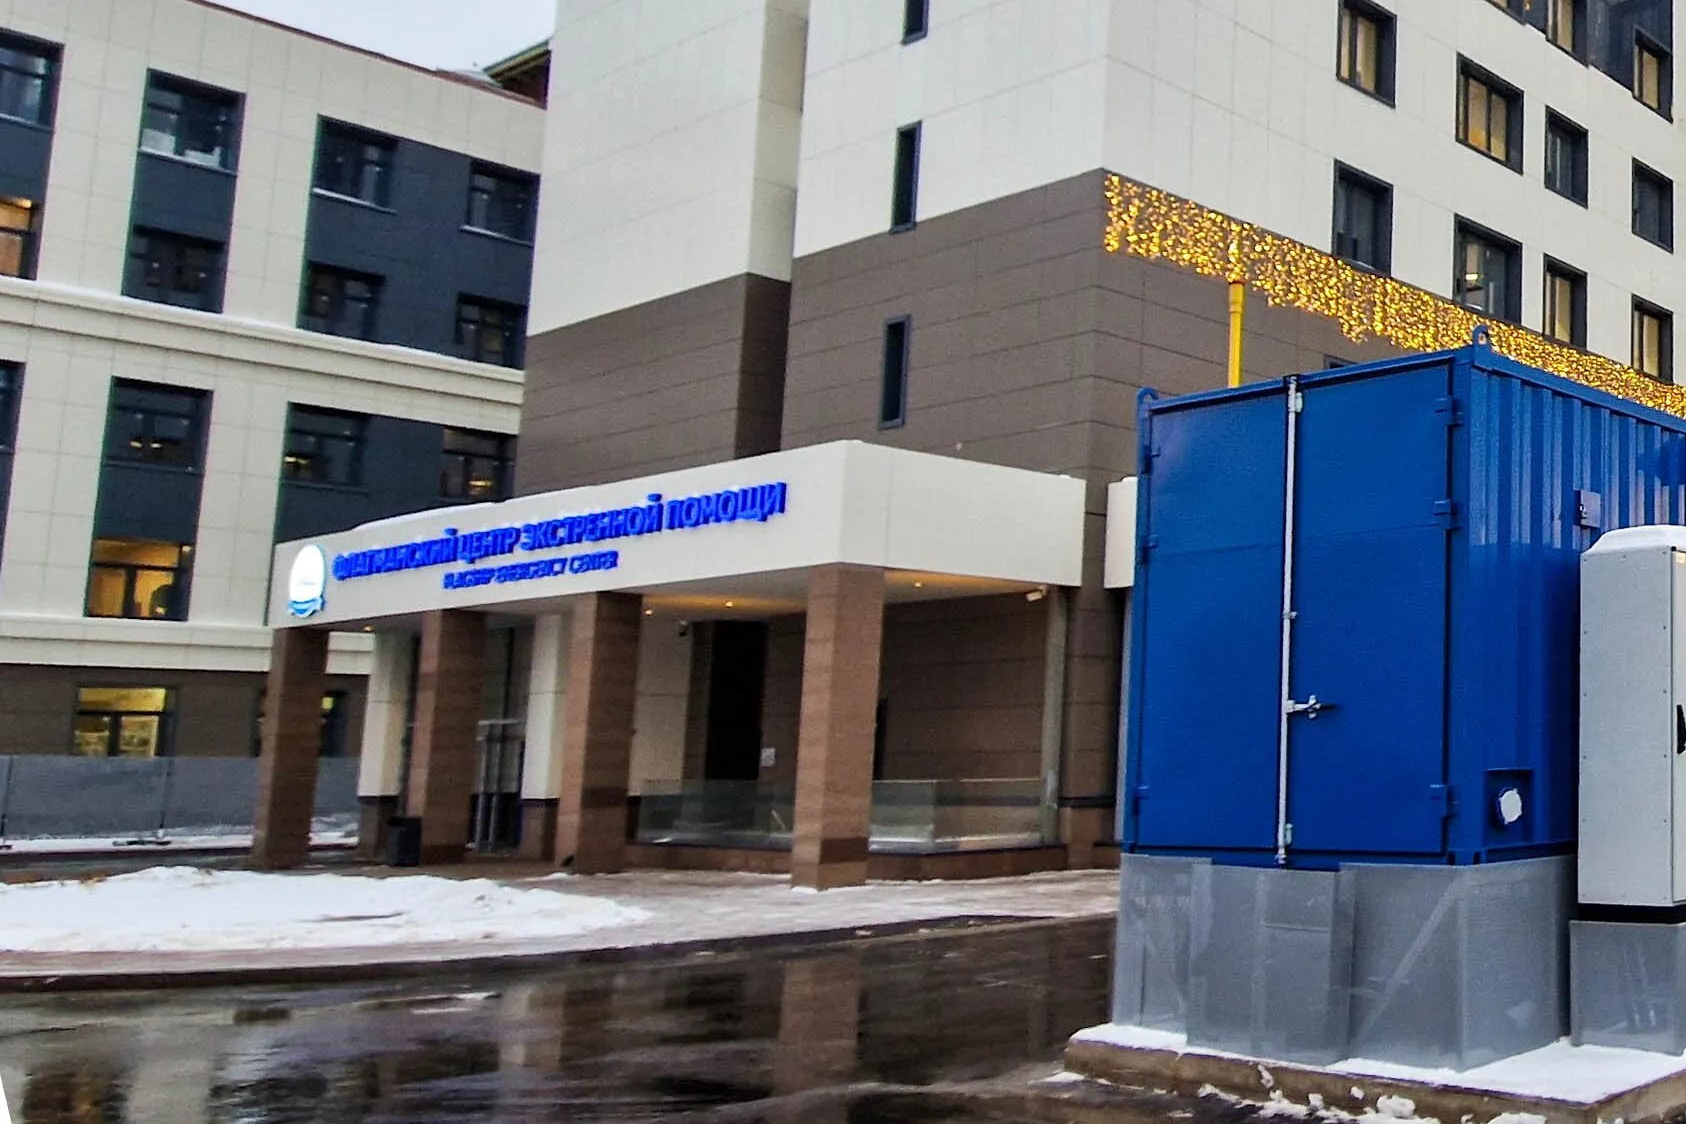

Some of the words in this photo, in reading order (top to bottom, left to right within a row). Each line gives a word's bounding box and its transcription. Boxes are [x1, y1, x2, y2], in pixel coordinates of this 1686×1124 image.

[458, 527, 521, 563] ЦЕНТР
[520, 493, 663, 551] ЭКСТРЕННОЙ
[665, 482, 787, 530] ПОМОЩИ
